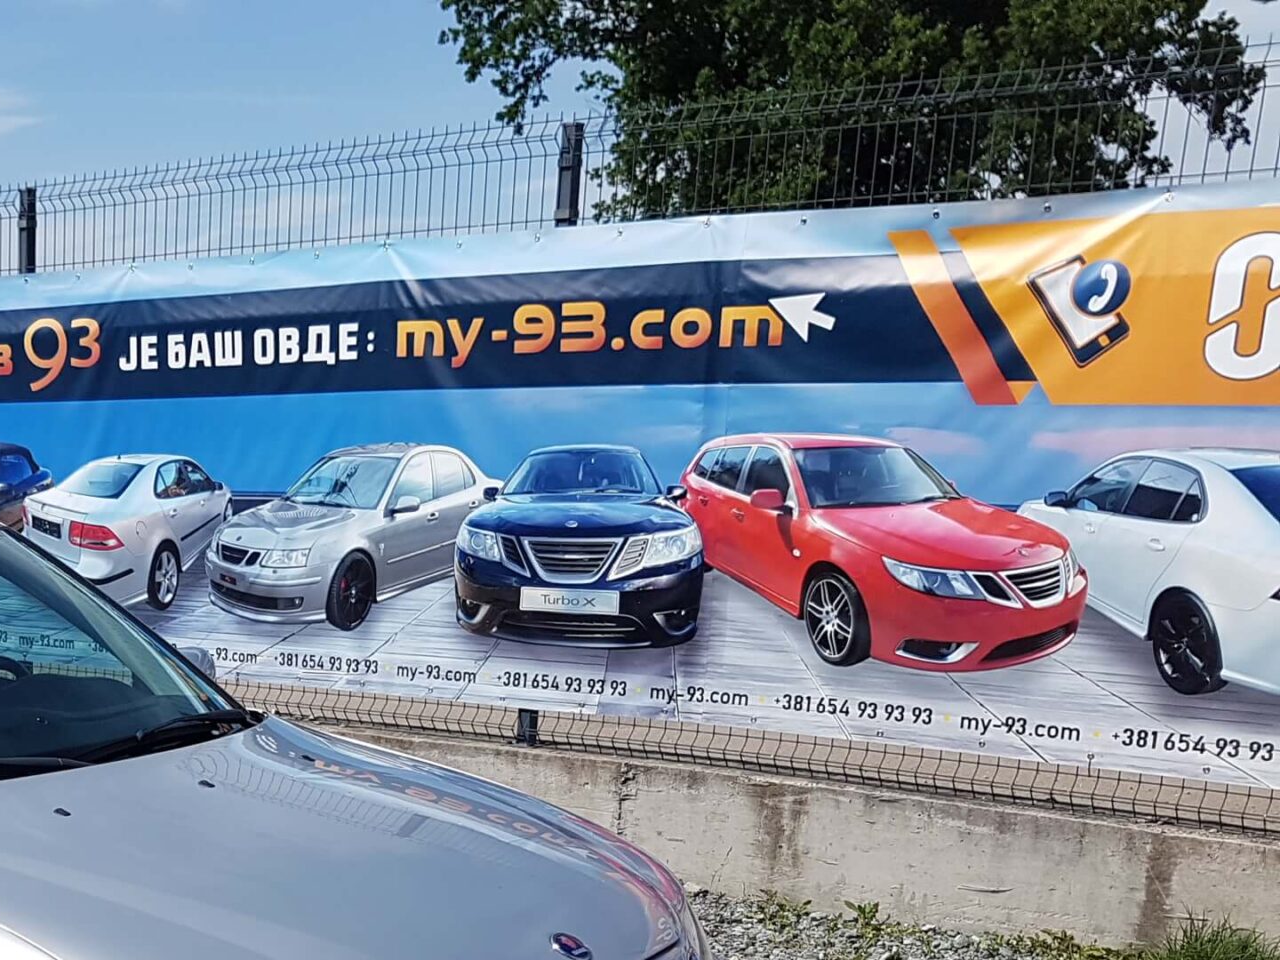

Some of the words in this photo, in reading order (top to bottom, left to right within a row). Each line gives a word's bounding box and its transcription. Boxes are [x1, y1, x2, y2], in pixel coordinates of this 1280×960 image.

[23, 317, 101, 392] 93
[118, 335, 158, 371] ЈЕ
[167, 330, 243, 369] БАШ
[396, 301, 784, 368] my-93.com
[540, 594, 580, 606] Turbo
[582, 597, 596, 607] X
[328, 654, 342, 671] 93
[346, 657, 360, 673] 93
[364, 659, 379, 674] 93
[396, 664, 476, 684] my-93.com
[565, 676, 582, 693] 93
[587, 678, 605, 695] 93
[610, 680, 627, 697] 93
[650, 685, 749, 706] my-93.com
[857, 701, 878, 720] 93
[884, 704, 905, 723] 93
[912, 706, 933, 725] 93
[960, 715, 1081, 742] my-93.com
[1215, 737, 1241, 758] 93
[1249, 740, 1275, 762] 93
